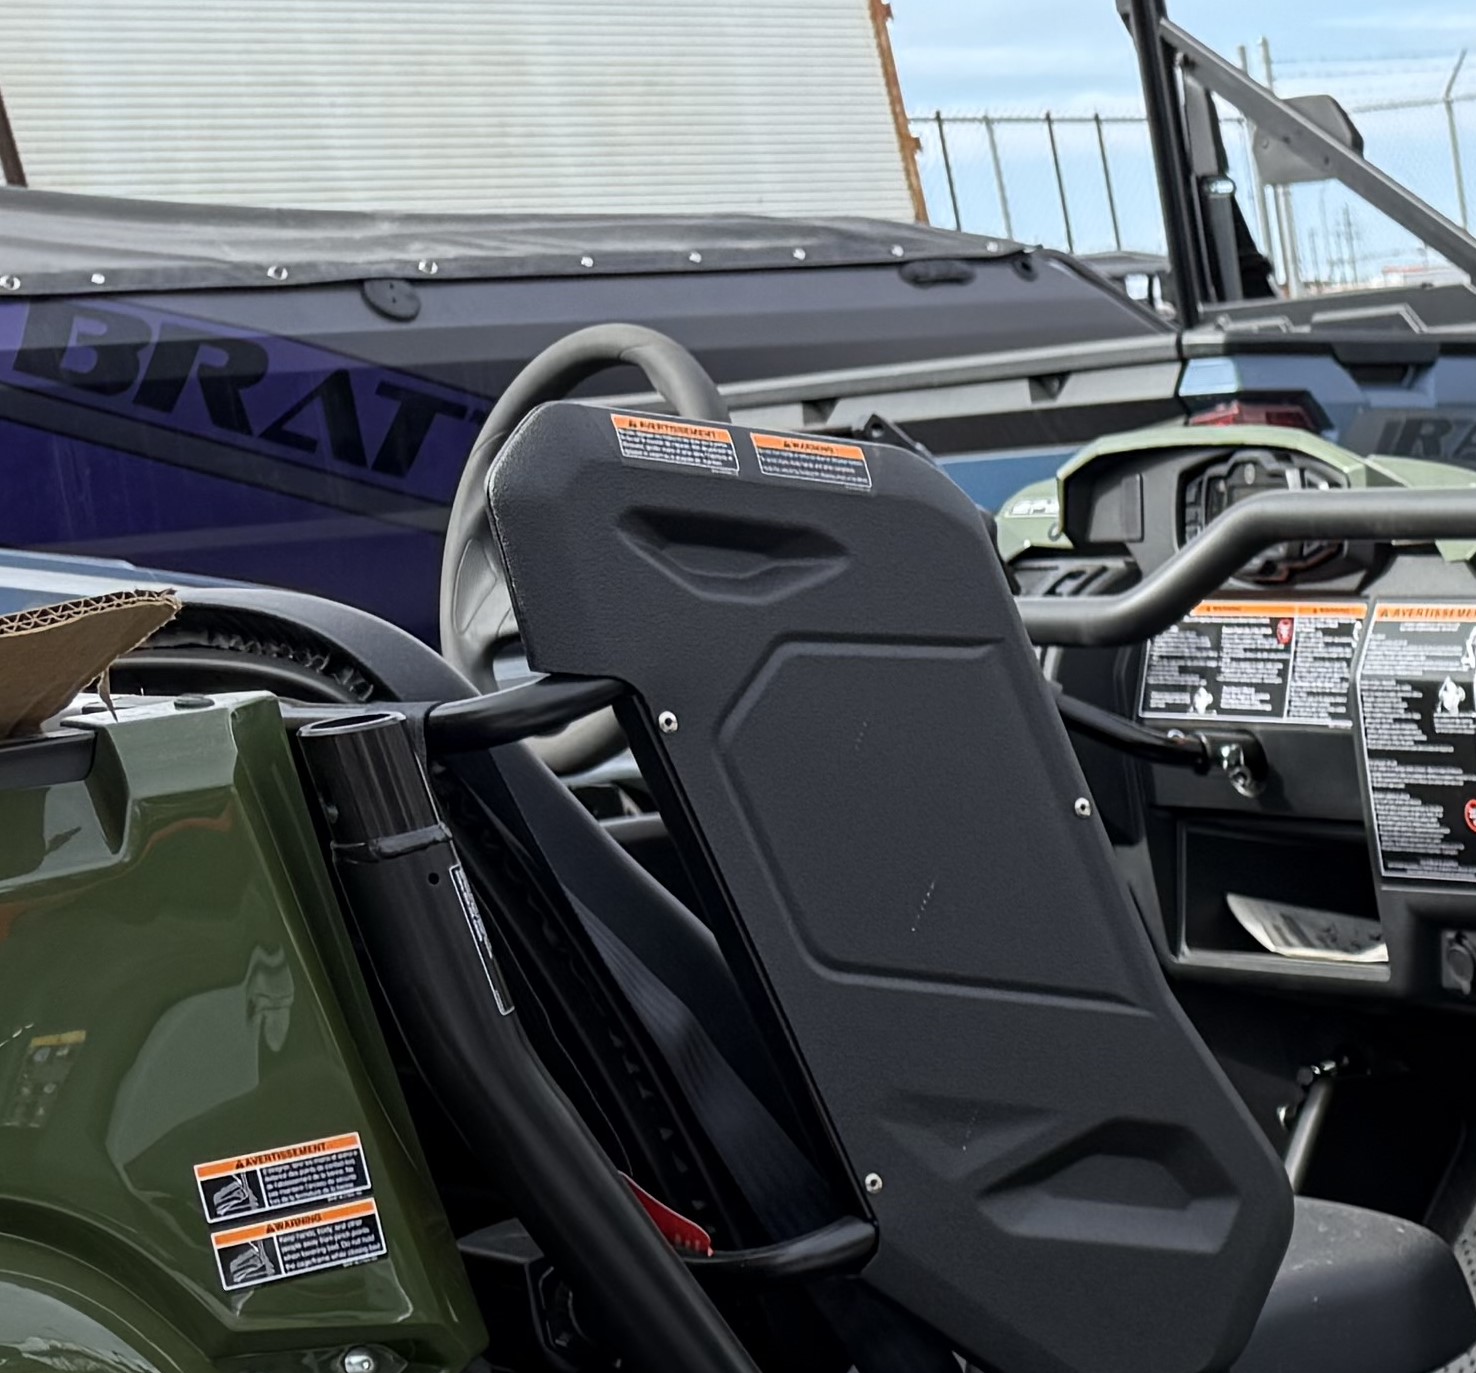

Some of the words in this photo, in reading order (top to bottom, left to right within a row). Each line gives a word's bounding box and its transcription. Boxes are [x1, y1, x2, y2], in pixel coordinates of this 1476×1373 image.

[12, 299, 468, 479] BRAT
[244, 1143, 326, 1166] AVERTISSEMENT
[274, 1213, 322, 1230] WARNING
